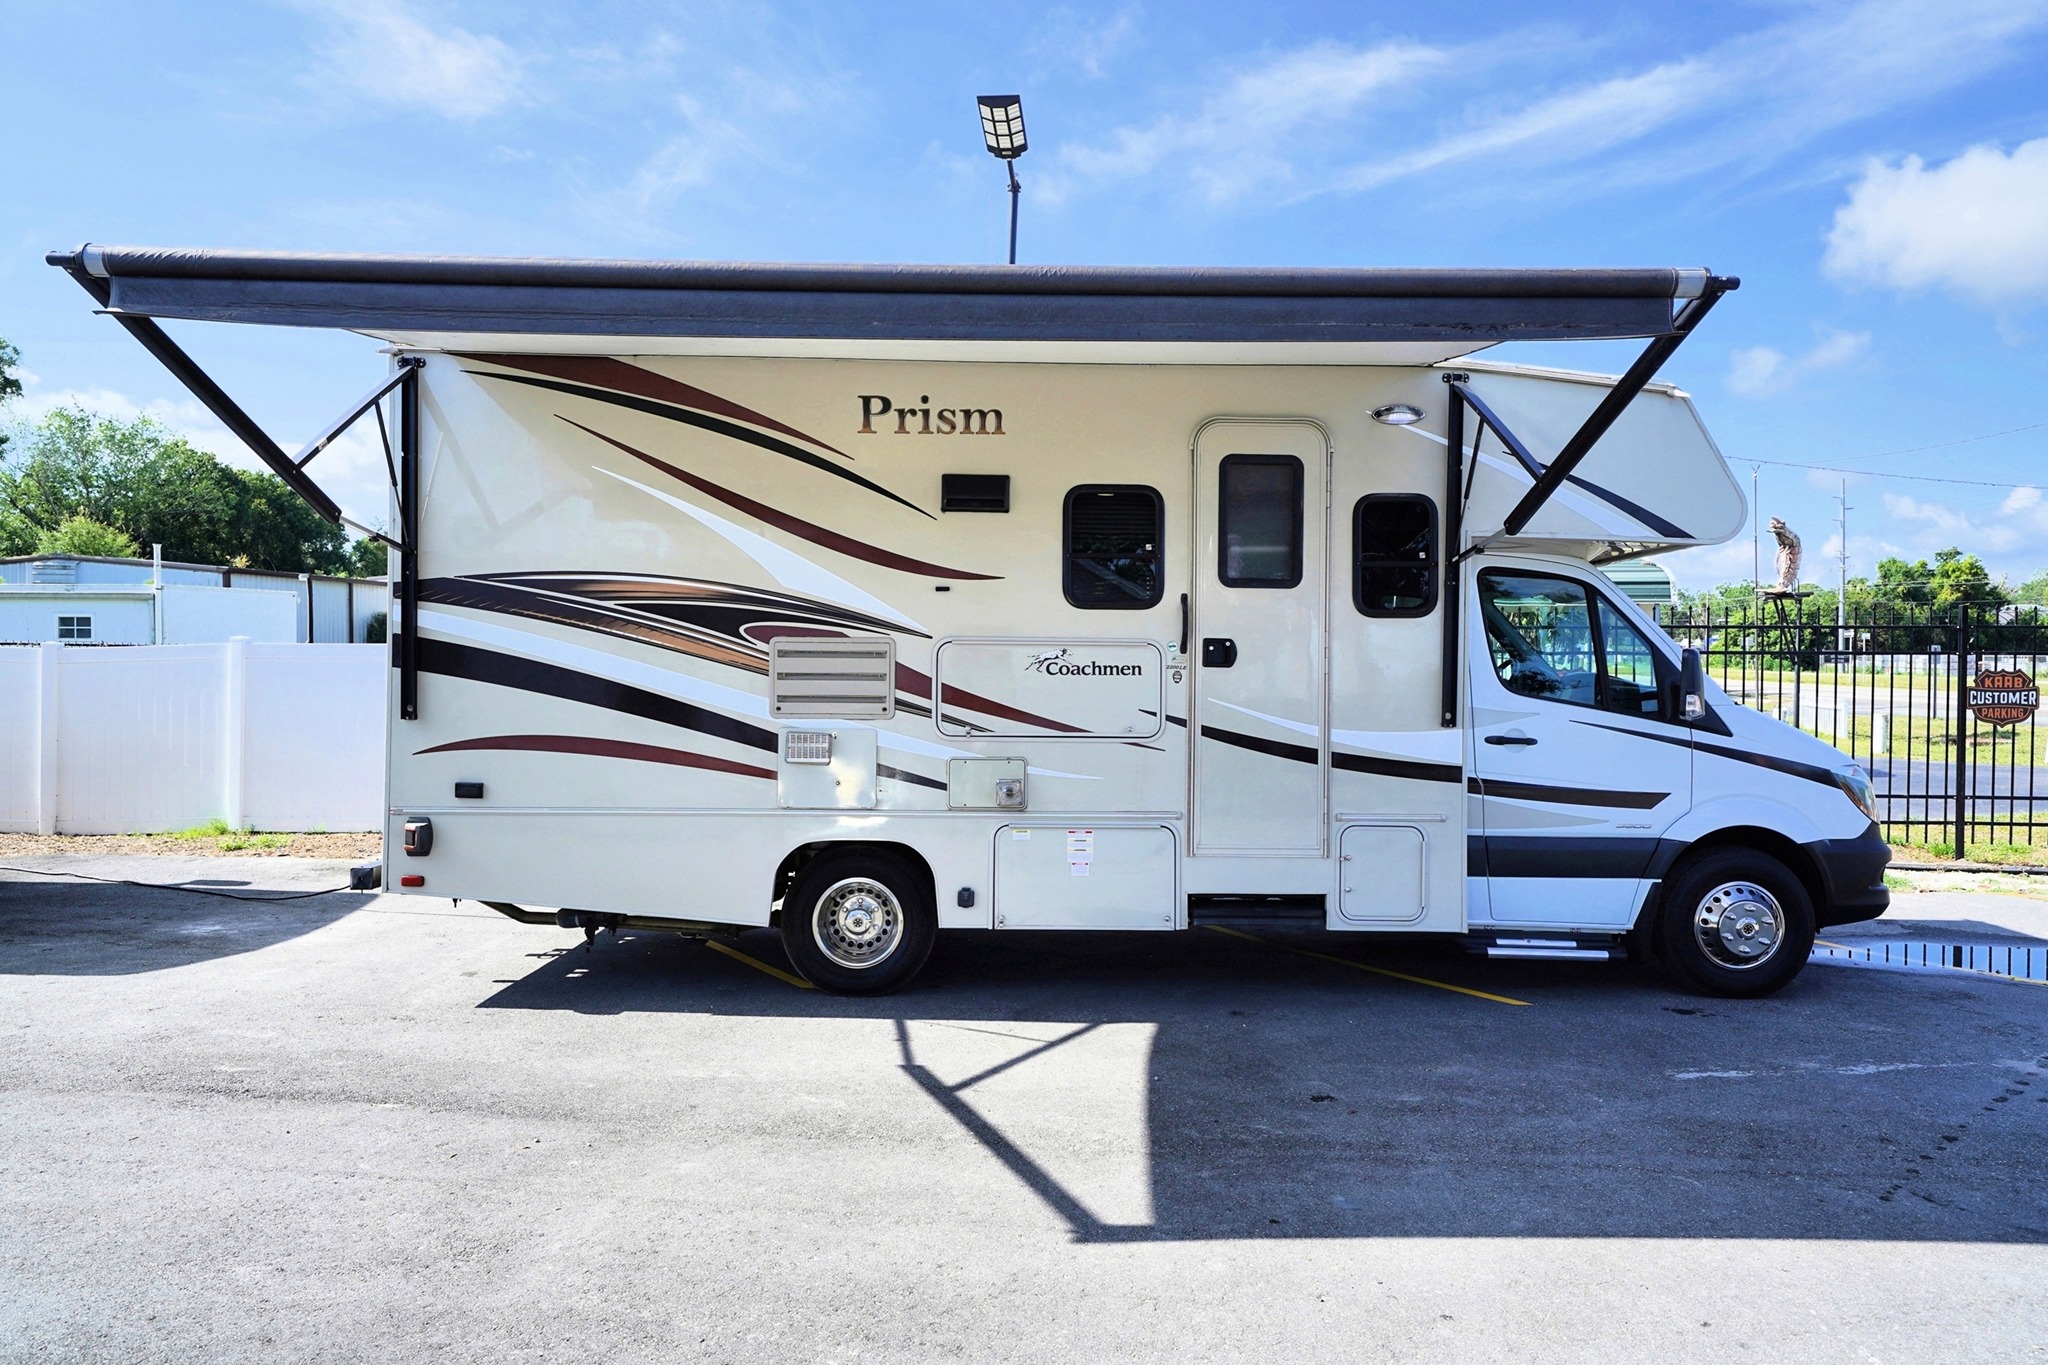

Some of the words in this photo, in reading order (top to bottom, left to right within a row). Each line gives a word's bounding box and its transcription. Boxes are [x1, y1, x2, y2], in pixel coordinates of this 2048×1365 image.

[857, 394, 1006, 435] Prism
[1045, 660, 1142, 676] Coachmen
[1984, 677, 2023, 688] KAAB
[1969, 691, 2036, 705] CUSTOMER
[1981, 708, 2024, 718] PARKING
